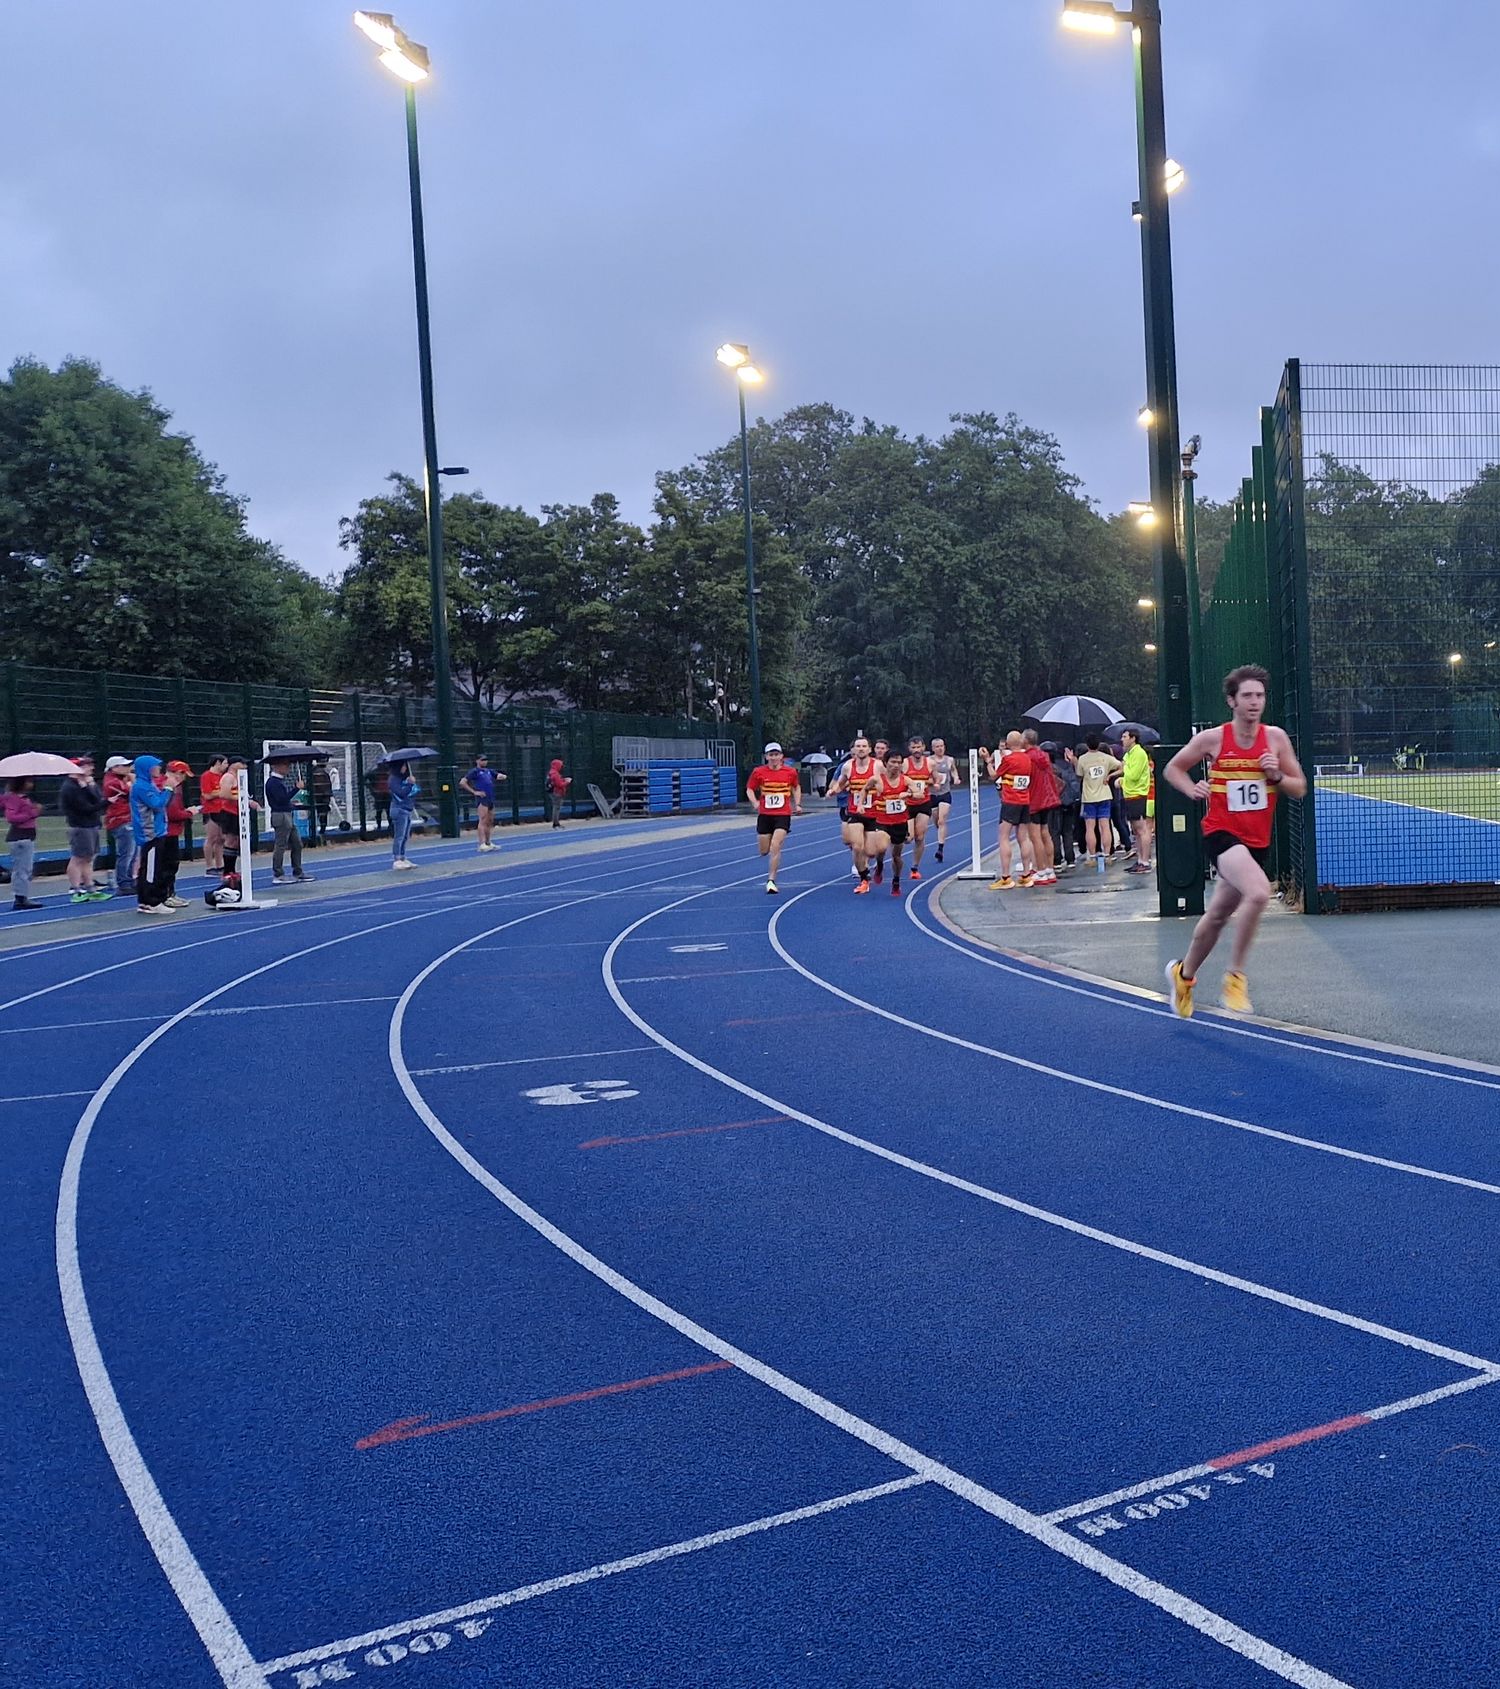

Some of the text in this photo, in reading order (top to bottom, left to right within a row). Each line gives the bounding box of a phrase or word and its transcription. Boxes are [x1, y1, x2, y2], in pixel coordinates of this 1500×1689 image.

[1017, 777, 1028, 788] 52
[769, 795, 780, 806] 12
[1237, 783, 1259, 805] 16
[520, 1080, 640, 1105] 3
